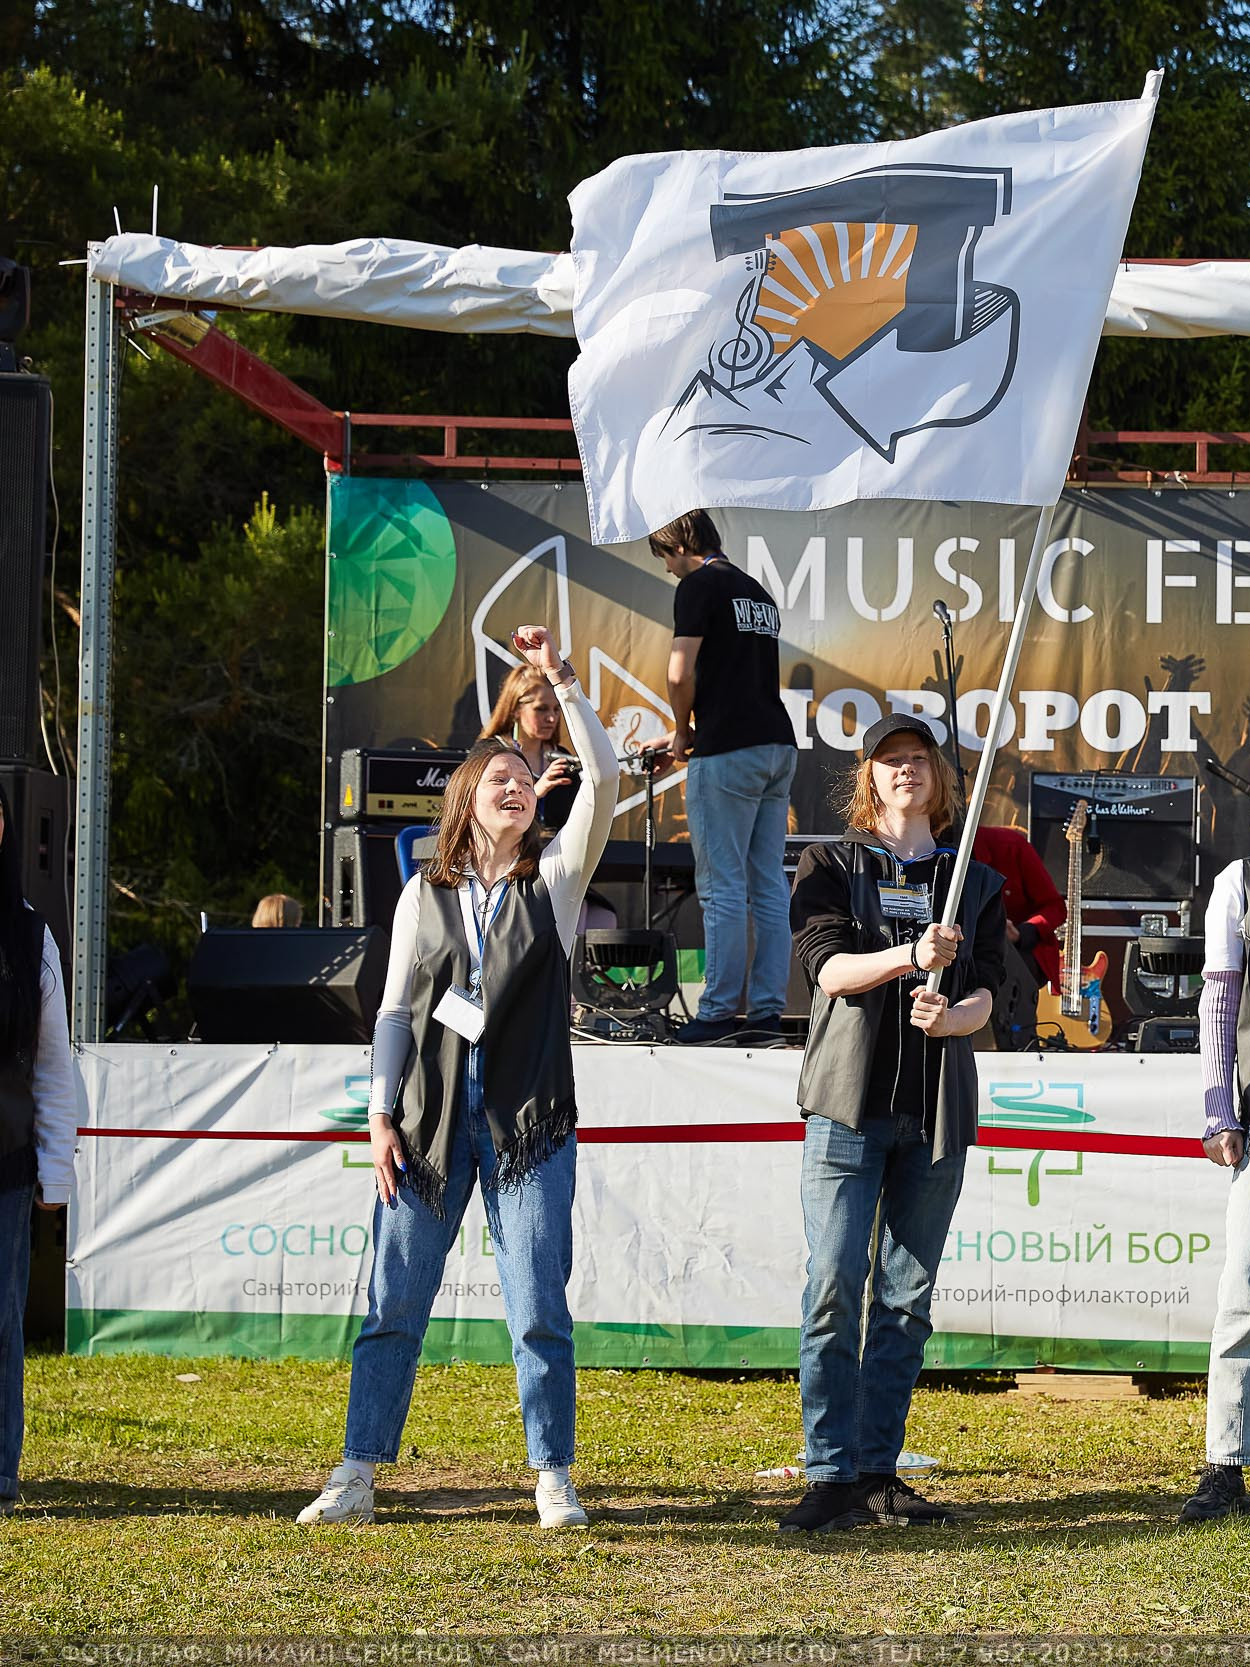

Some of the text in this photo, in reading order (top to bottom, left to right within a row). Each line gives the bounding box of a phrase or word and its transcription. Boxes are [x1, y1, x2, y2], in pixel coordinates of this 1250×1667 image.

[745, 536, 1096, 623] MUSIC
[221, 1223, 465, 1257] СОСНО
[941, 1224, 1211, 1264] НОВЫЙ БОР
[931, 1283, 1190, 1307] аторий-профилакторий
